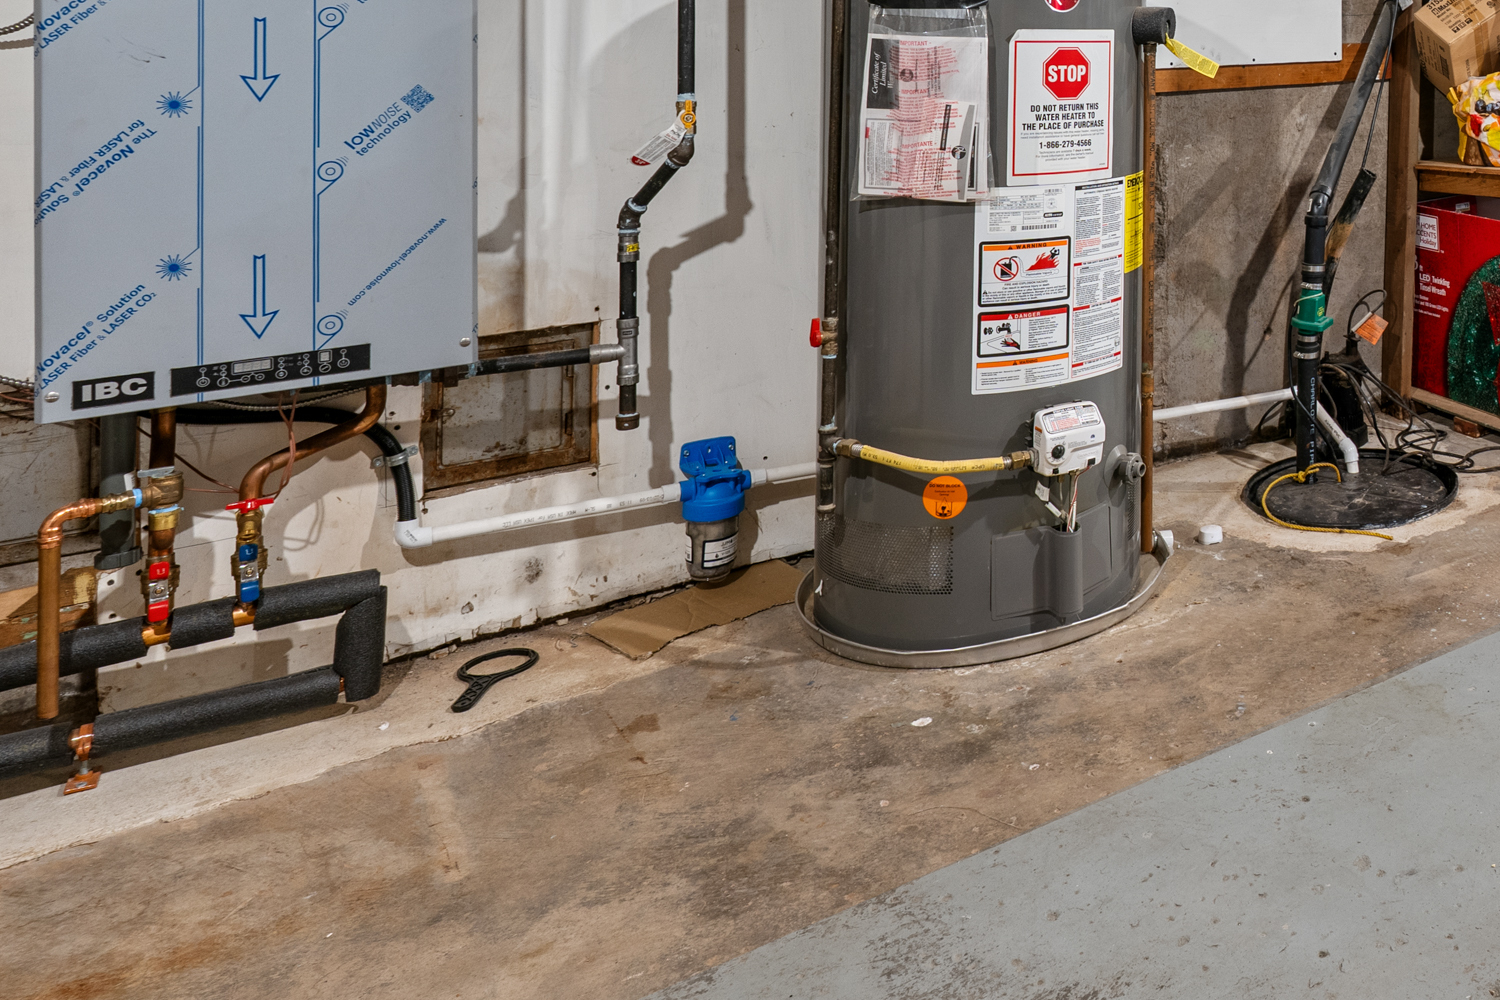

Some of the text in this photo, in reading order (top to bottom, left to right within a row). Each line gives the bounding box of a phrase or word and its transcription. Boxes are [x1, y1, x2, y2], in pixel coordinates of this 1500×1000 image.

[38, 23, 73, 49] LASER
[69, 3, 99, 25] Fiber
[871, 61, 882, 94] Certificate
[1047, 64, 1087, 83] STOP
[1030, 102, 1099, 113] DO NOT RETURN THIS
[1035, 111, 1096, 121] WATER HEATER TO
[127, 119, 146, 133] for
[355, 110, 412, 157] technology
[1022, 120, 1104, 131] THE PLACE OF PURCHASE
[94, 130, 131, 157] LASER
[131, 128, 158, 145] The
[1039, 139, 1092, 149] 1-866-279-4566
[68, 156, 98, 178] Fiber
[34, 194, 70, 227] Solutio
[1417, 230, 1437, 239] CCENTS
[1421, 223, 1436, 231] HOME
[347, 217, 448, 306] www.novacel-lownoise.com
[1420, 273, 1431, 282] LED
[96, 284, 146, 322] Solution
[1014, 311, 1041, 319] DANGER
[39, 361, 73, 390] LASER
[69, 339, 98, 362] Fiber
[102, 307, 139, 335] LASER
[81, 377, 149, 402] IBC
